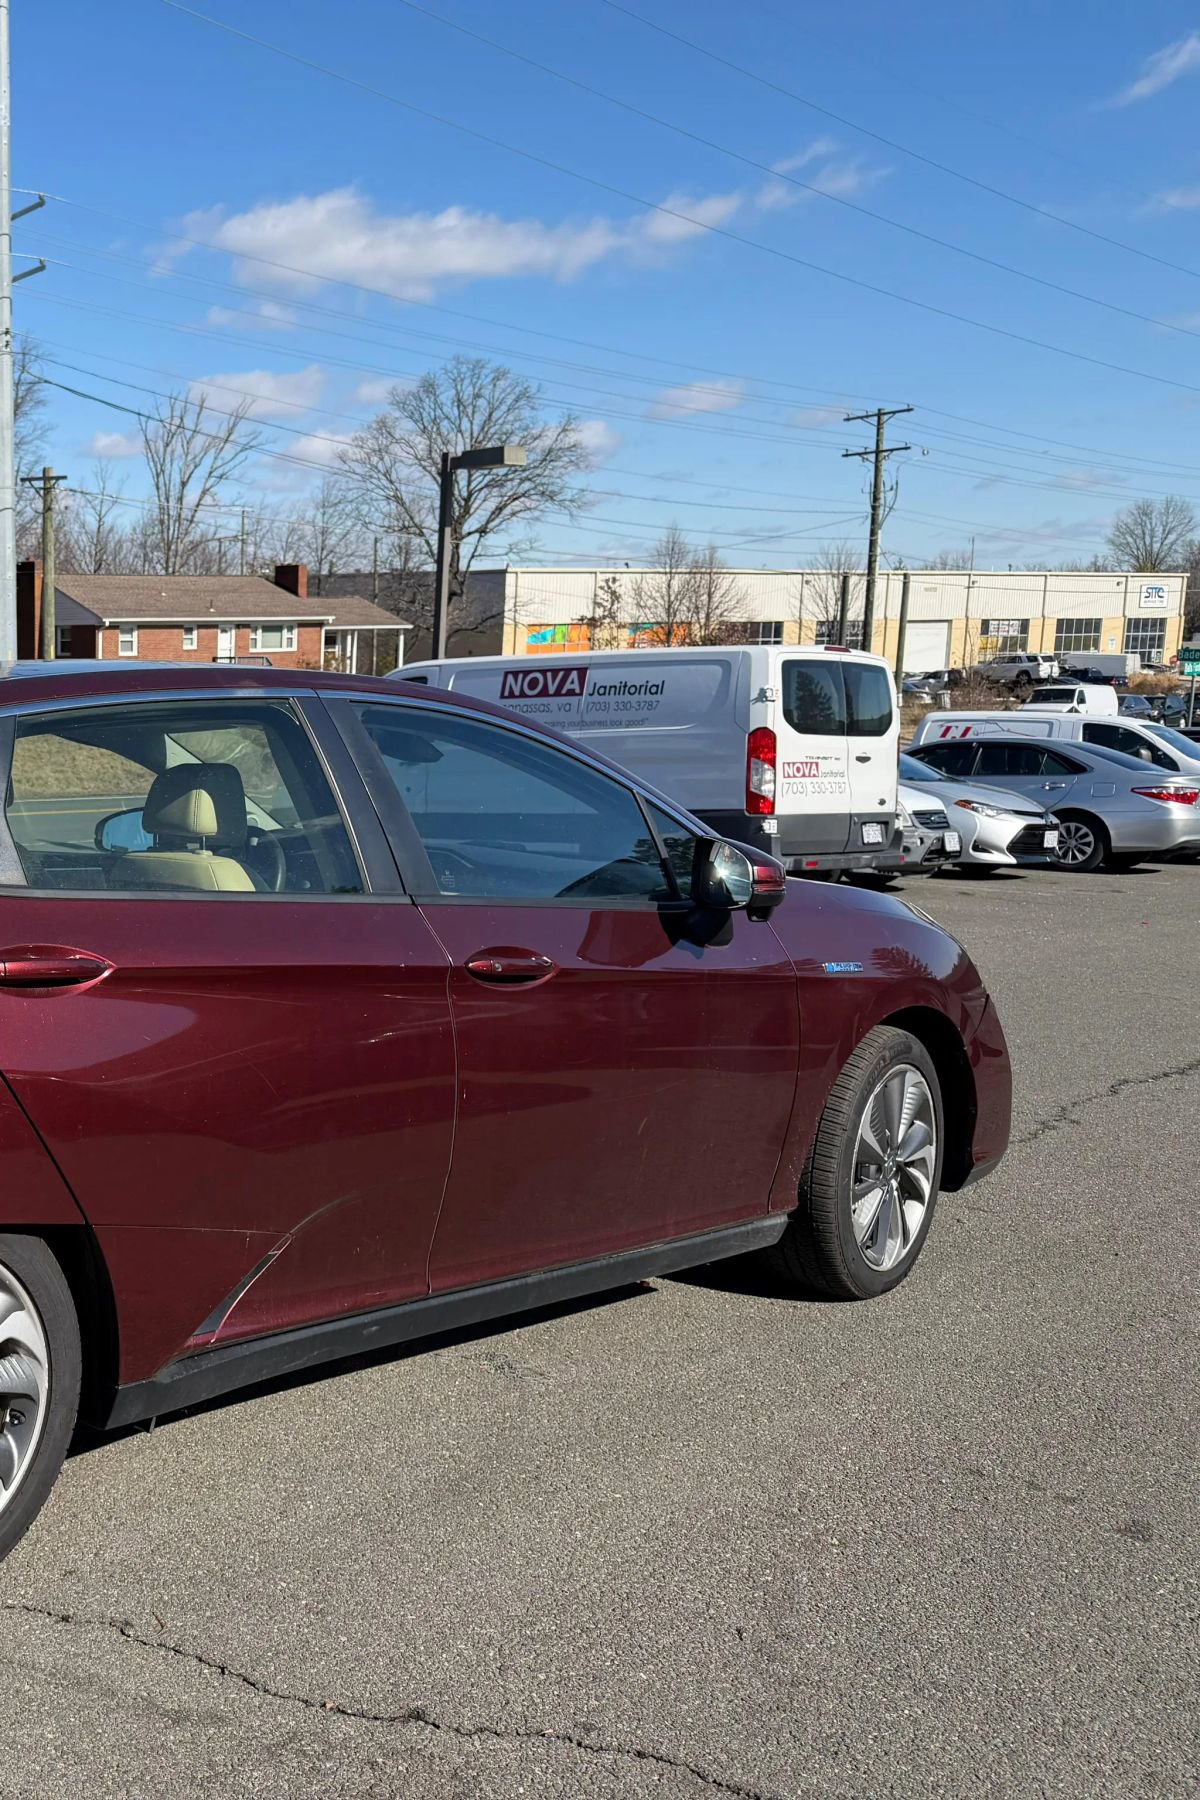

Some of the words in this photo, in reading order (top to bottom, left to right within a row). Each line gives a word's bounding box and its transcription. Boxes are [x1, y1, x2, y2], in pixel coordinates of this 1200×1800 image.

[503, 670, 581, 697] NOVA
[588, 680, 665, 697] Janitorial
[557, 702, 572, 713] va
[586, 701, 610, 713] (703)
[613, 700, 660, 712] 330-3787
[784, 763, 818, 777] NOVA
[781, 782, 807, 798] (703)
[810, 781, 846, 795] 330-3787
